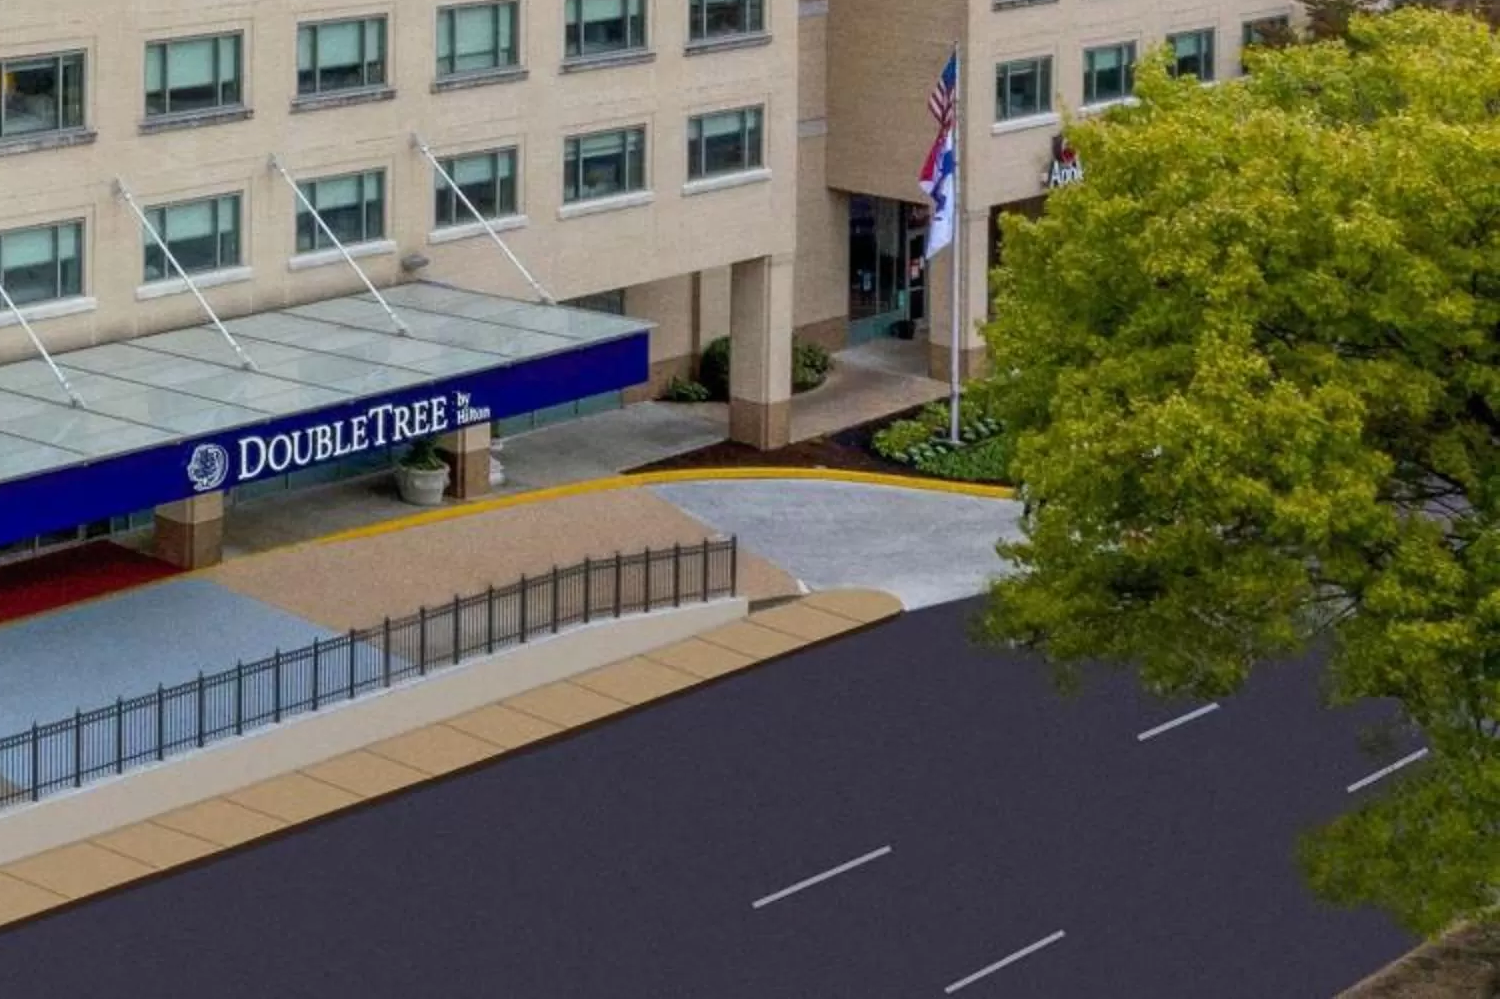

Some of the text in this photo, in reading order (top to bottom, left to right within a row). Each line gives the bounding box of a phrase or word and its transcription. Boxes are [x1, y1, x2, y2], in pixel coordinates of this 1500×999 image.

[457, 392, 471, 409] by
[457, 407, 490, 425] Hilton
[238, 397, 448, 480] DOUBLETREE
